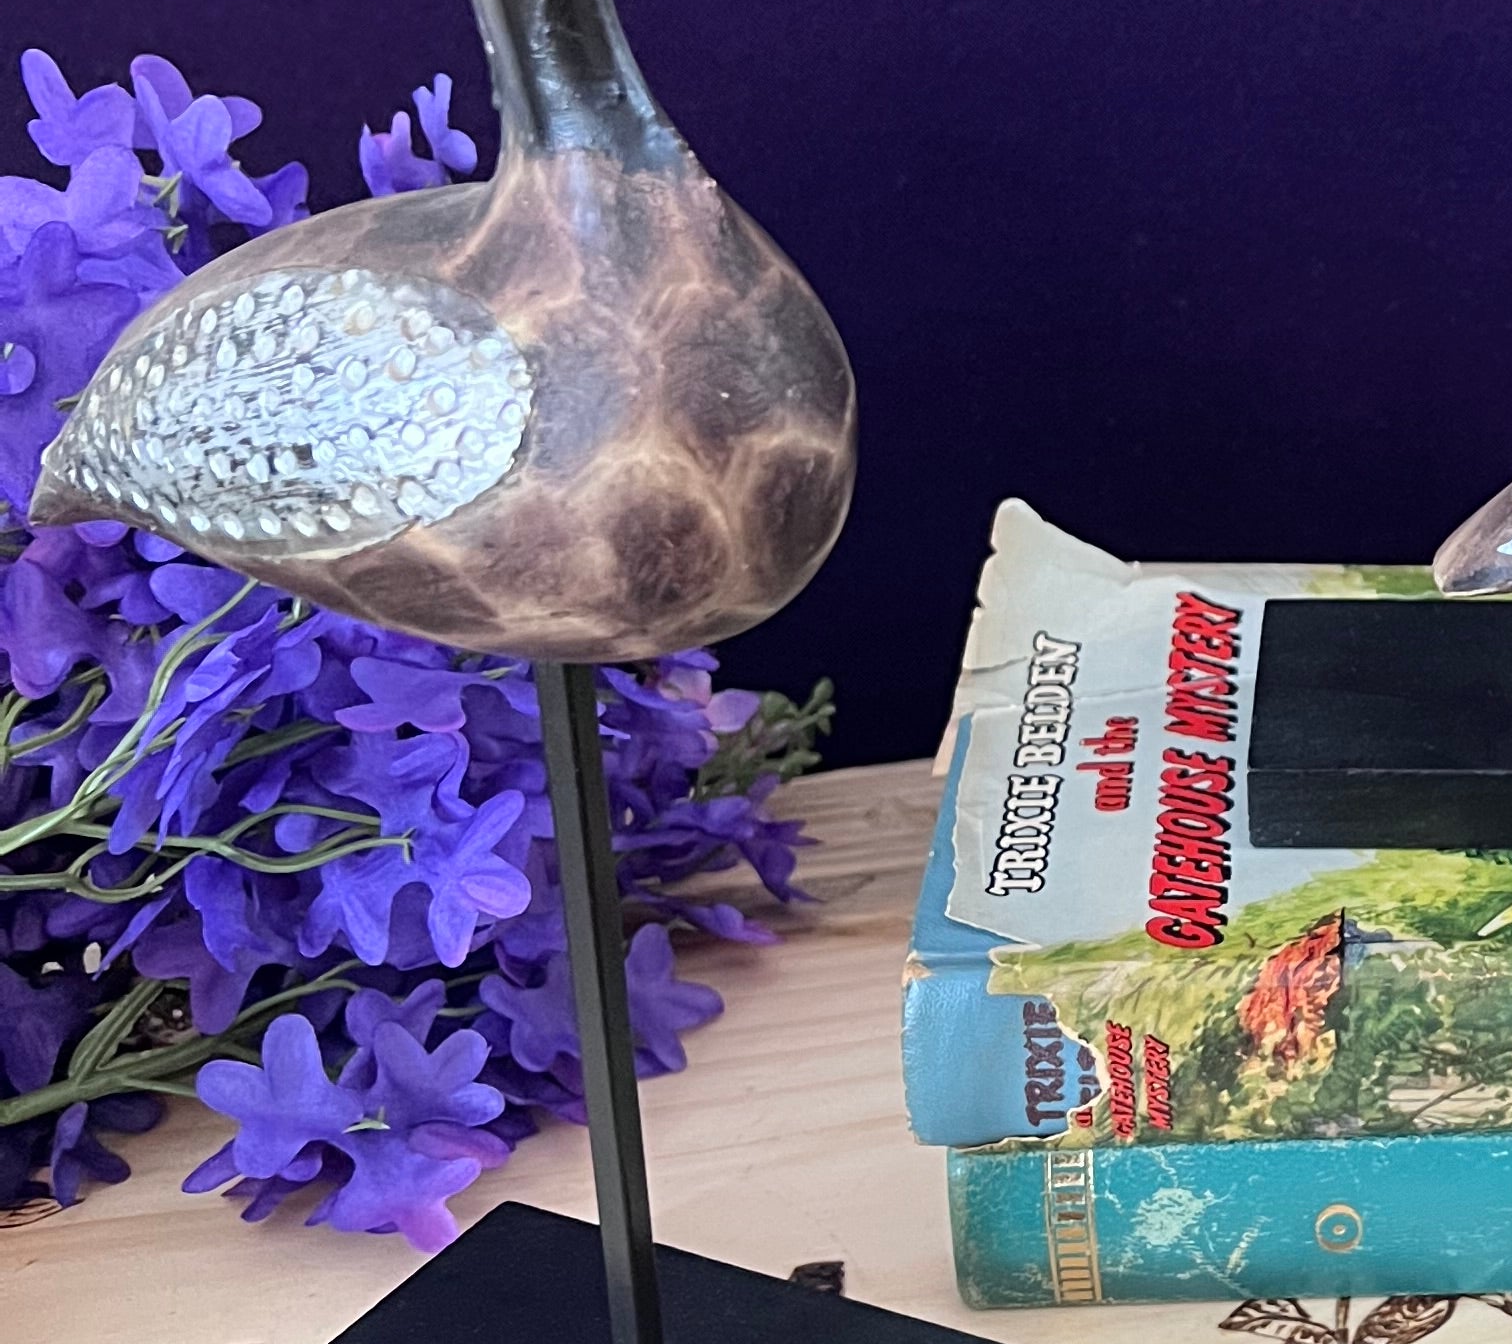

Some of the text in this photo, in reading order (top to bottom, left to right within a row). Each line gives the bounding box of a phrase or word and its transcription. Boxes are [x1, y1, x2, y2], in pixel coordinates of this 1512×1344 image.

[985, 630, 1082, 896] TRIXIE BELDEN
[1076, 716, 1139, 812] and the
[1145, 591, 1244, 949] GATEHOUSE MYSTERY
[1023, 1001, 1065, 1127] TRIXIE
[1106, 1019, 1136, 1139] GATEHOUSE
[1143, 1033, 1173, 1131] MYSTERY
